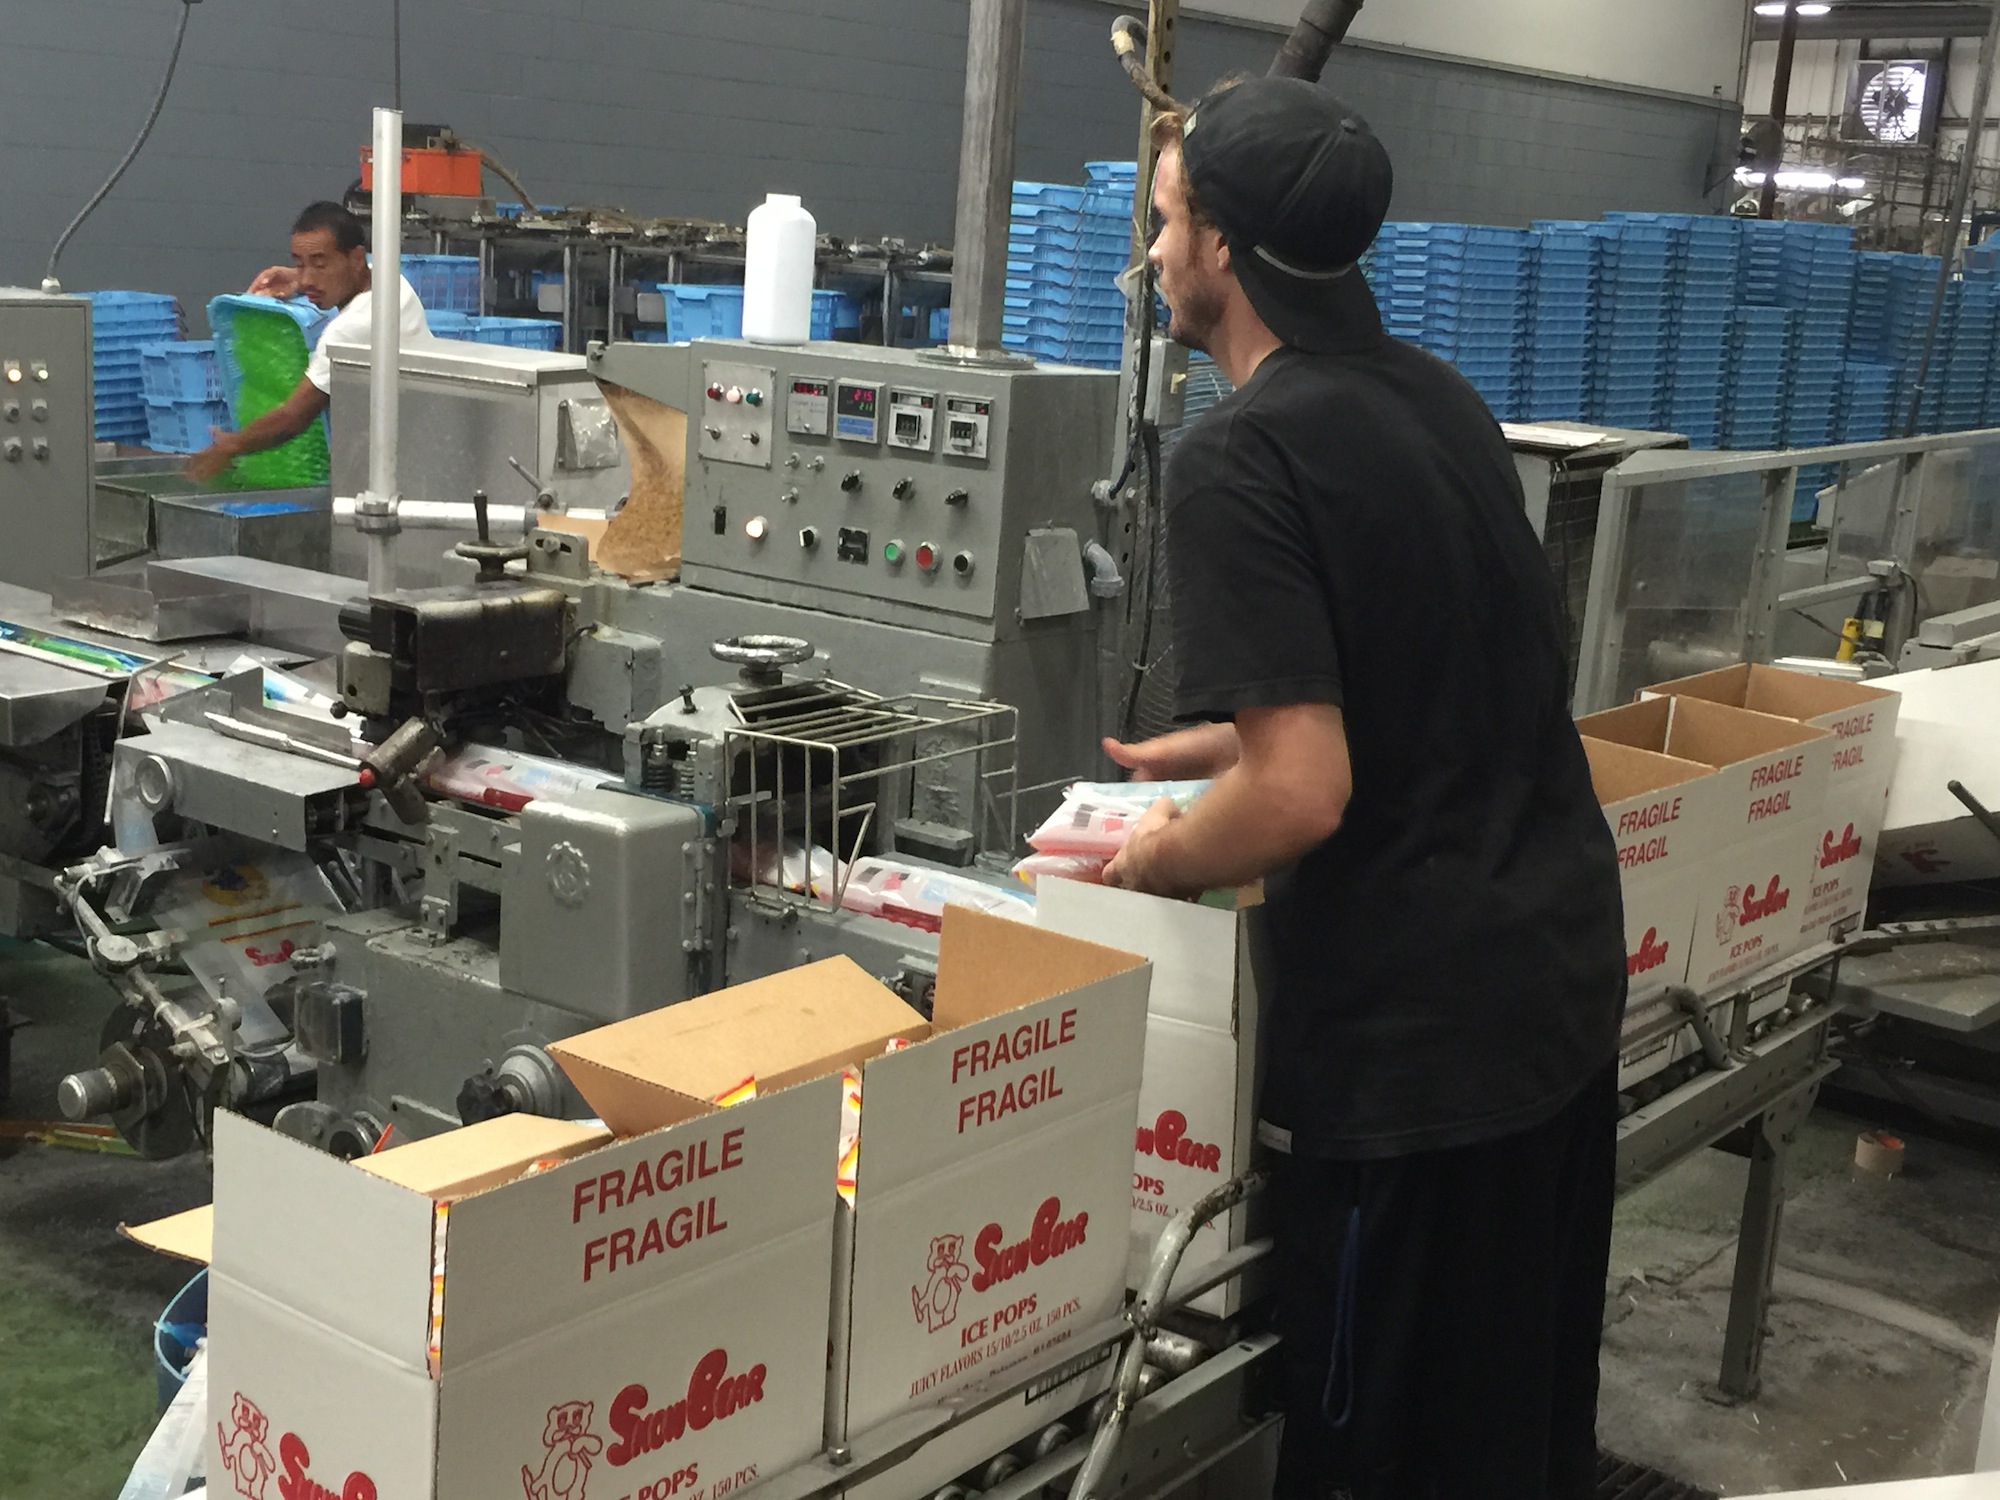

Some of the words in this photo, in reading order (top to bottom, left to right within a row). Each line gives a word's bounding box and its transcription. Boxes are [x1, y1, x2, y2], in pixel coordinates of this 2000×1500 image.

[1750, 755, 1804, 791] FRAGILE
[1832, 745, 1864, 771] RAGIL
[1617, 797, 1682, 837] FRAGILE
[1747, 790, 1791, 823] FRAGIL
[1617, 836, 1668, 869] FRAGIL
[952, 1008, 1077, 1084] FRAGILE
[958, 1066, 1063, 1134] FRAGIL
[572, 1126, 745, 1224] FRAGILE
[1132, 1173, 1164, 1195] OPS
[583, 1197, 728, 1283] FRAGIL
[960, 1317, 989, 1348] ICE
[992, 1293, 1037, 1332] POPS
[909, 1366, 938, 1399] JUICY
[940, 1348, 984, 1383] FLAVORS
[1046, 1307, 1061, 1327] 150
[637, 1462, 698, 1500] POPS
[711, 1476, 731, 1500] 150
